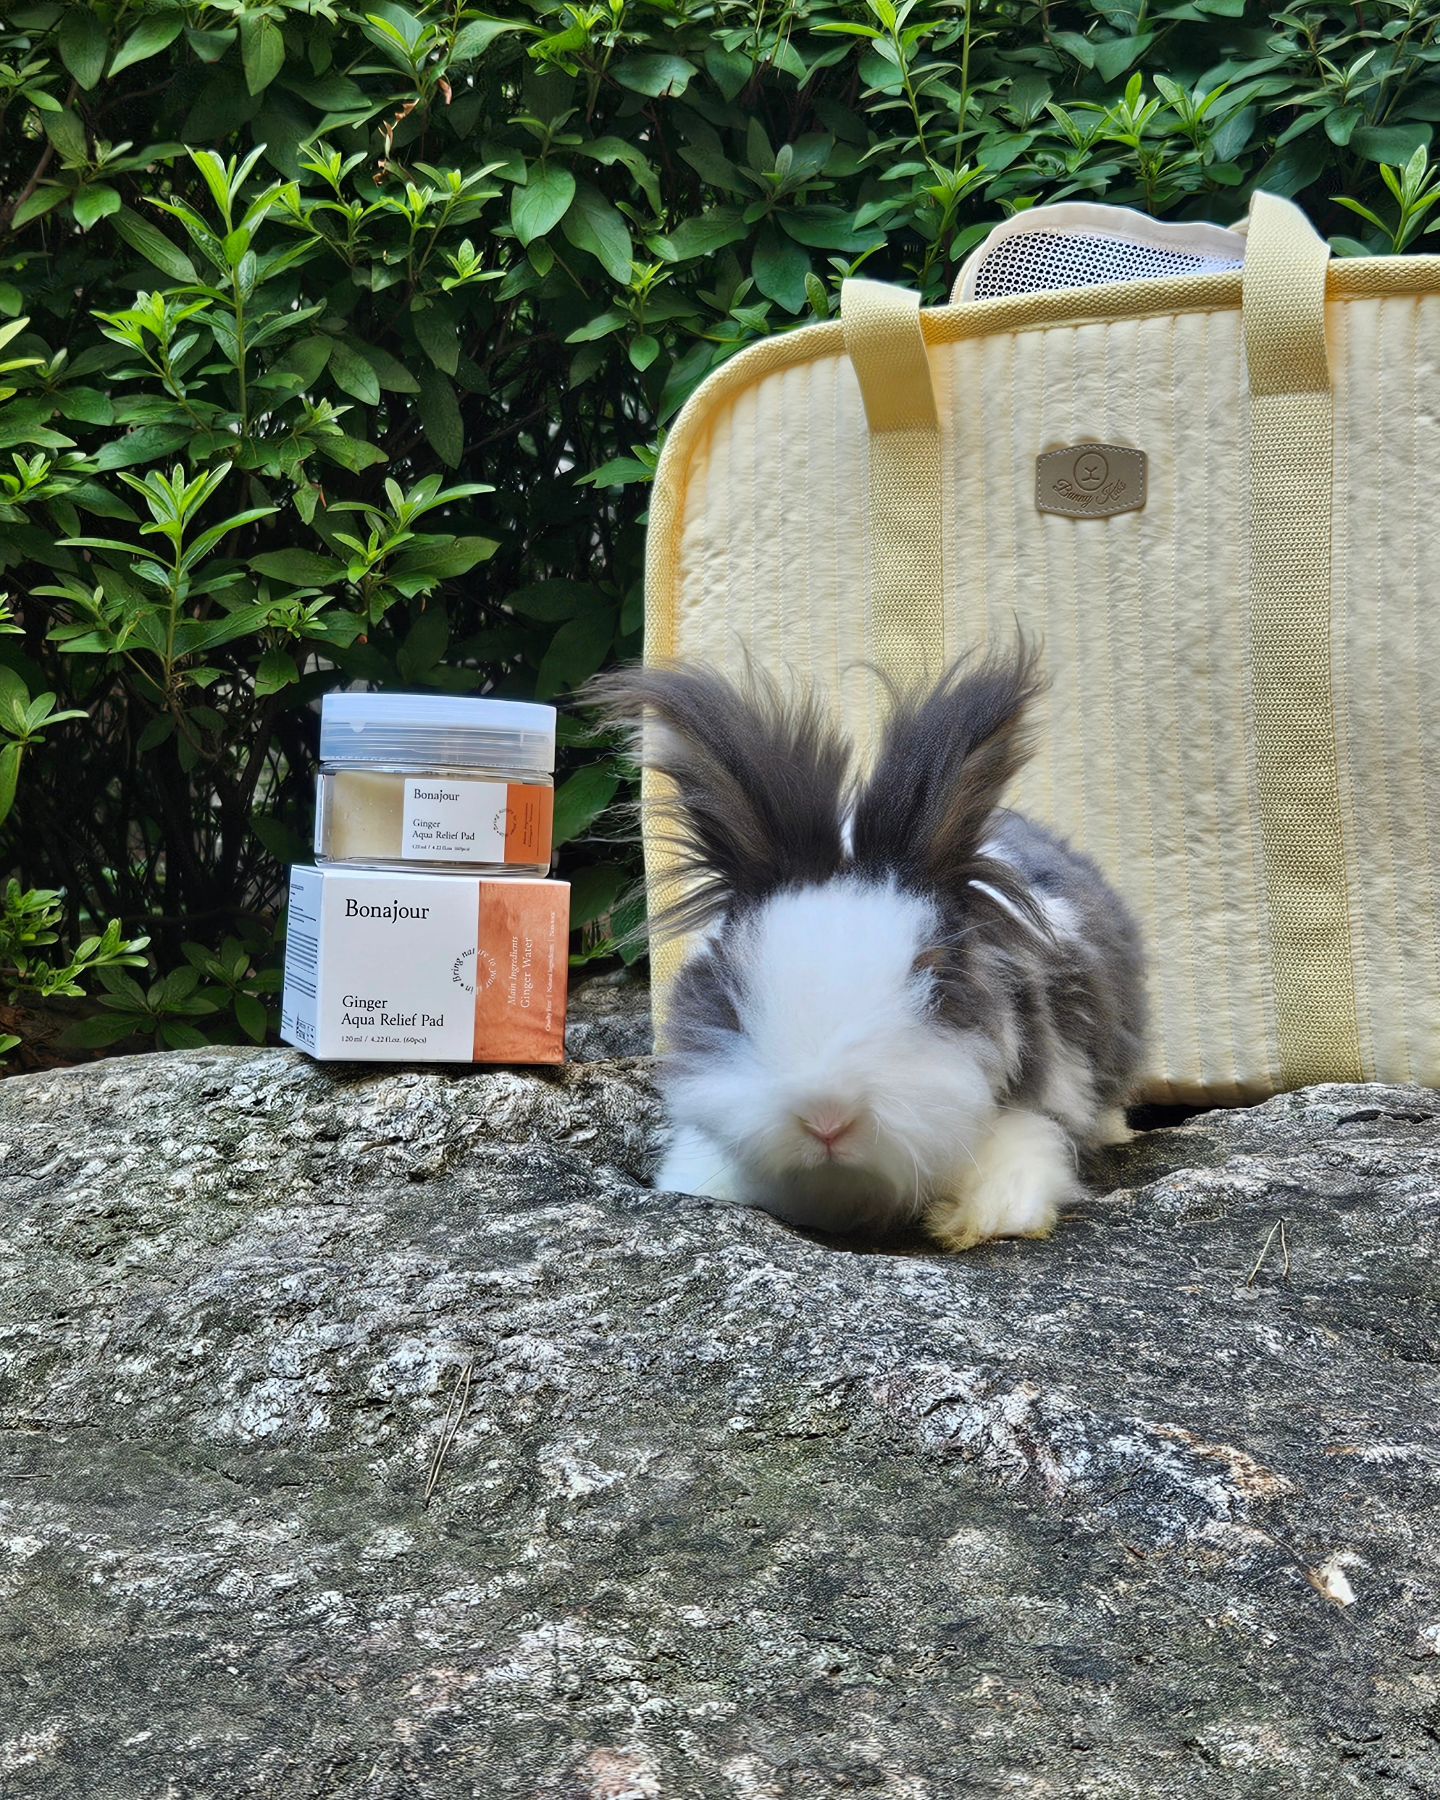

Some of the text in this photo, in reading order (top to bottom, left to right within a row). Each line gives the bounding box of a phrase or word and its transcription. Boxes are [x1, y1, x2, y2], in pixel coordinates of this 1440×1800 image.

[1052, 479, 1094, 508] Bunny
[414, 788, 460, 803] Bonajour
[413, 818, 441, 829] Ginger
[412, 830, 475, 841] Aqua Relief Pad
[345, 898, 430, 924] Bonajour
[450, 957, 465, 983] Bring
[507, 935, 520, 1006] Main Ingredients
[520, 937, 534, 1009] Ginger Water
[342, 994, 388, 1012] Ginger
[341, 1012, 444, 1029] Aqua Relief Pad
